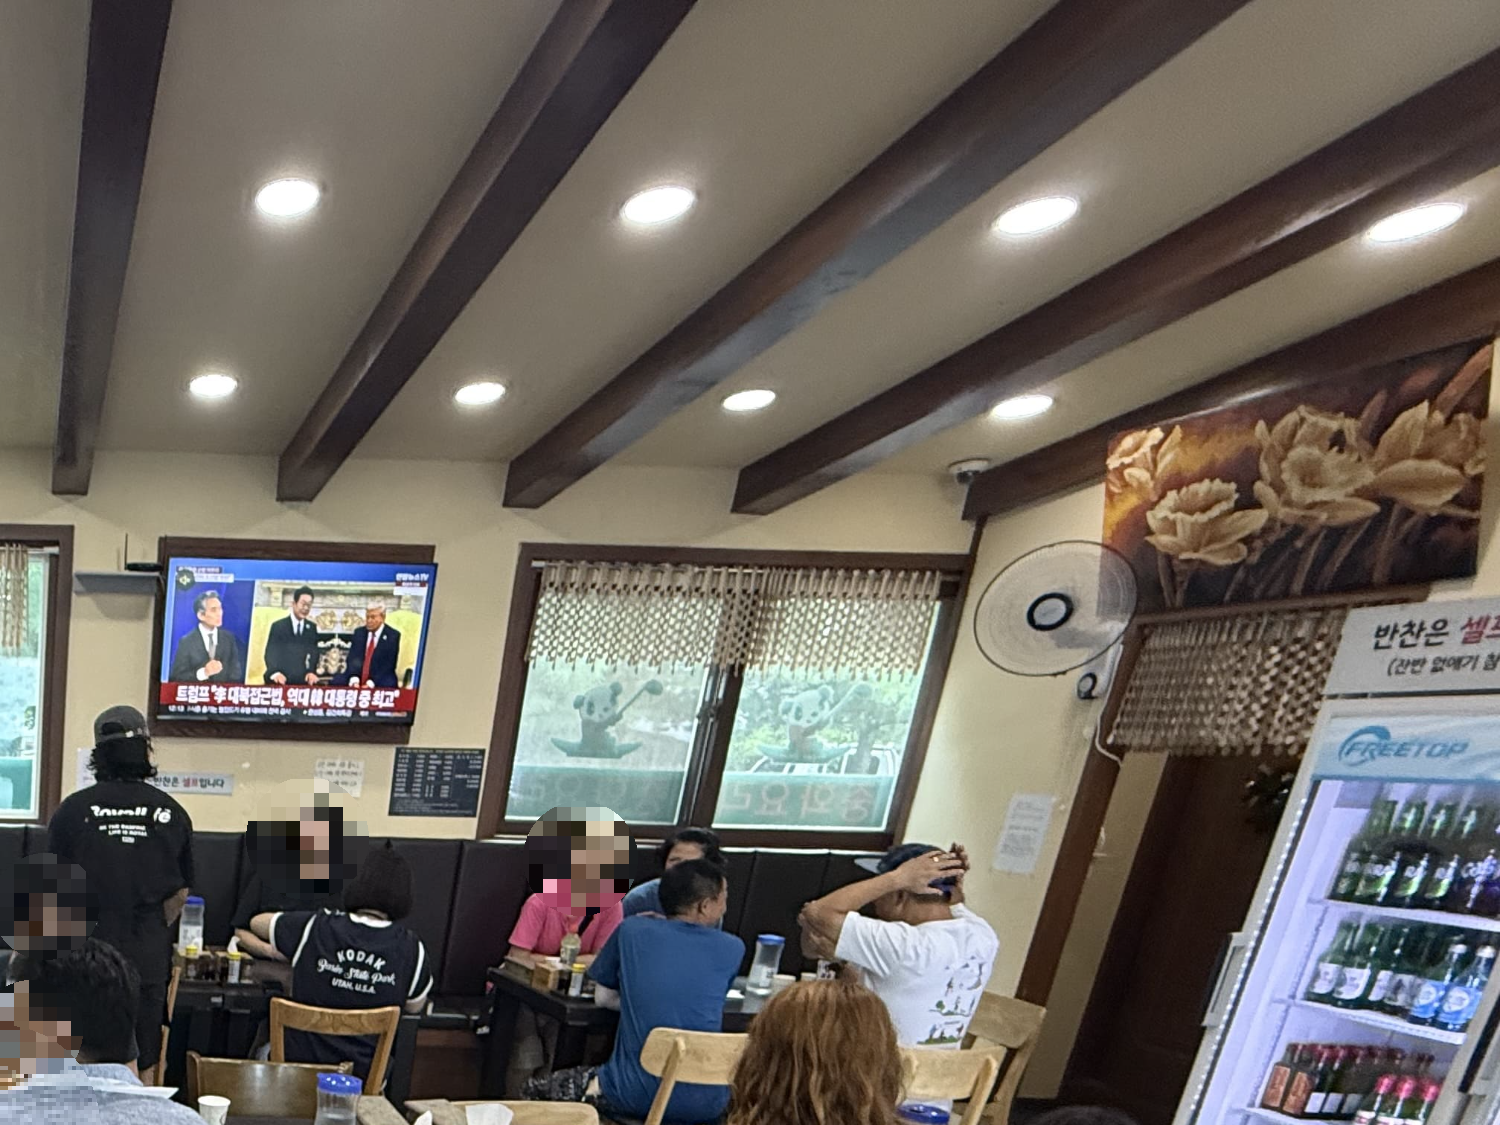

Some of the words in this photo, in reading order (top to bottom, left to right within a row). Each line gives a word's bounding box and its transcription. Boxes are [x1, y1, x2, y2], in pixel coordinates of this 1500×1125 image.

[1373, 618, 1449, 650] 반찬은
[1387, 656, 1427, 676] (잔반
[175, 685, 211, 703] 트럼프
[336, 949, 386, 971] KODAK
